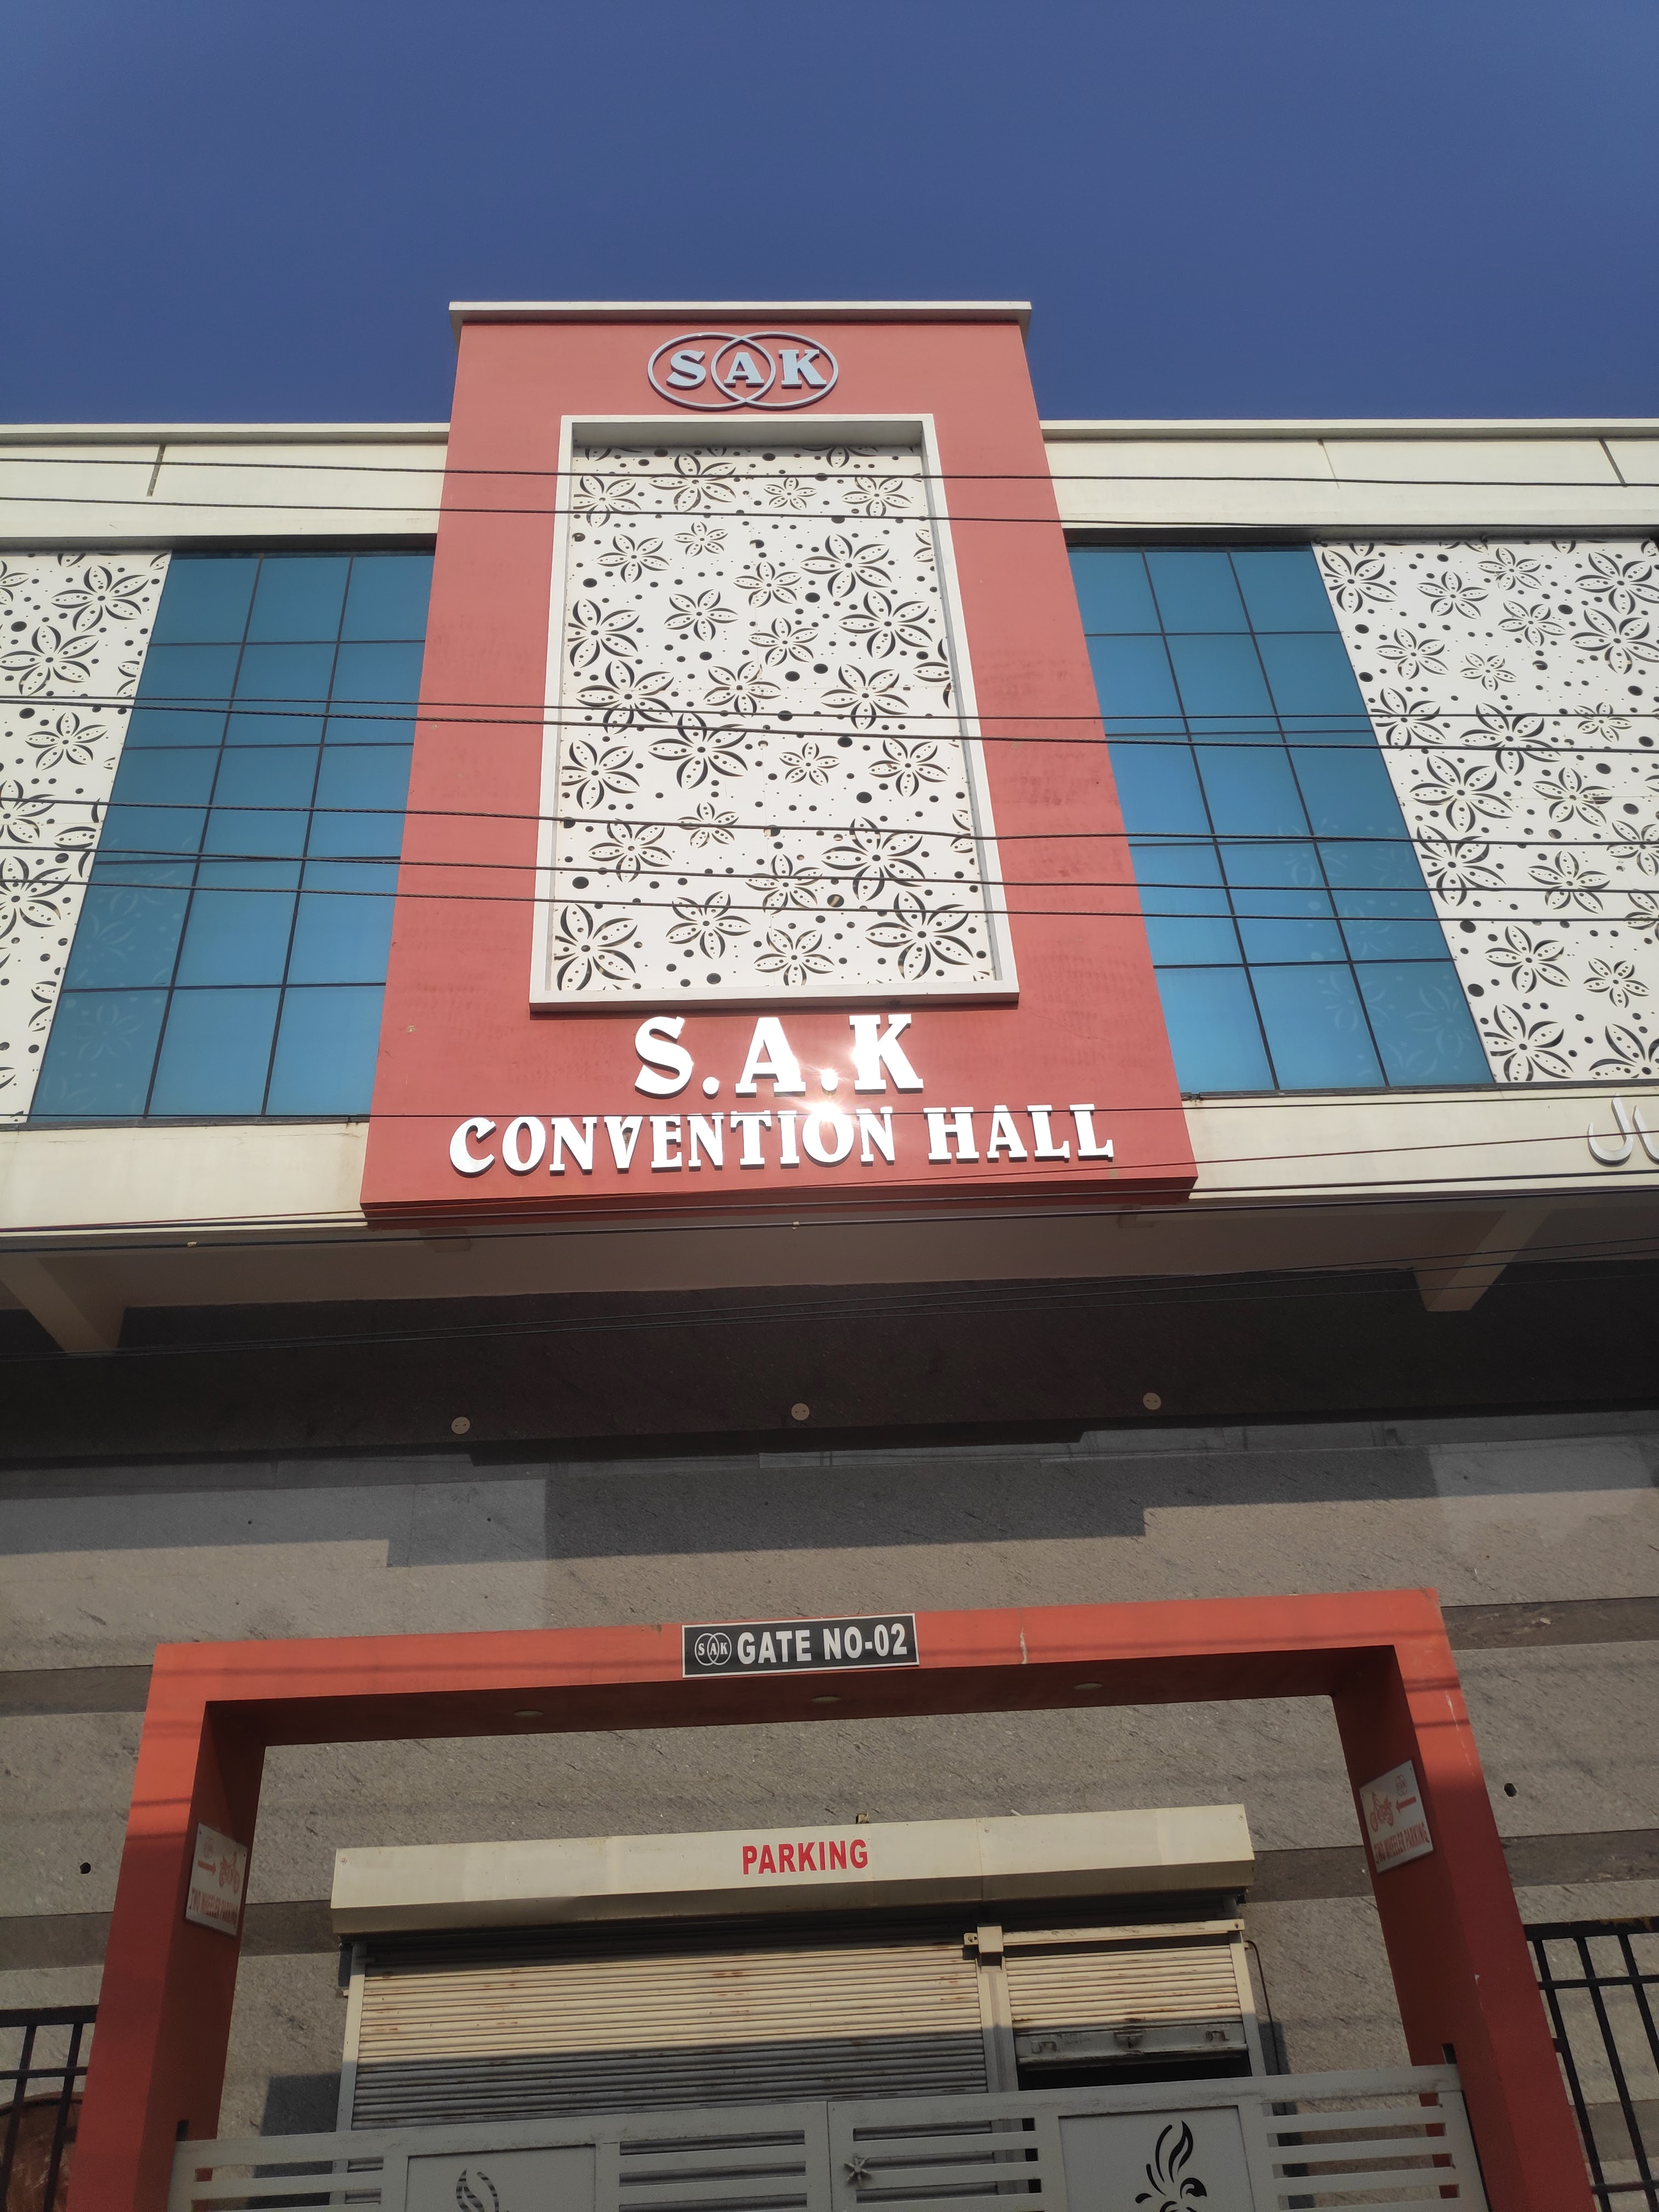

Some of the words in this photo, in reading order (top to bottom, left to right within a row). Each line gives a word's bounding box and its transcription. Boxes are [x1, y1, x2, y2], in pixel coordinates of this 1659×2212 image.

[666, 349, 827, 388] SAK
[634, 1014, 924, 1097] S.A.K
[449, 1105, 895, 1176] CONVENTION
[923, 1103, 1114, 1162] HALL
[697, 1643, 729, 1656] SAK
[737, 1629, 812, 1664] GATE
[823, 1623, 908, 1660] NO-02
[1404, 1821, 1428, 1849] PARKING
[742, 1839, 868, 1875] PARKING
